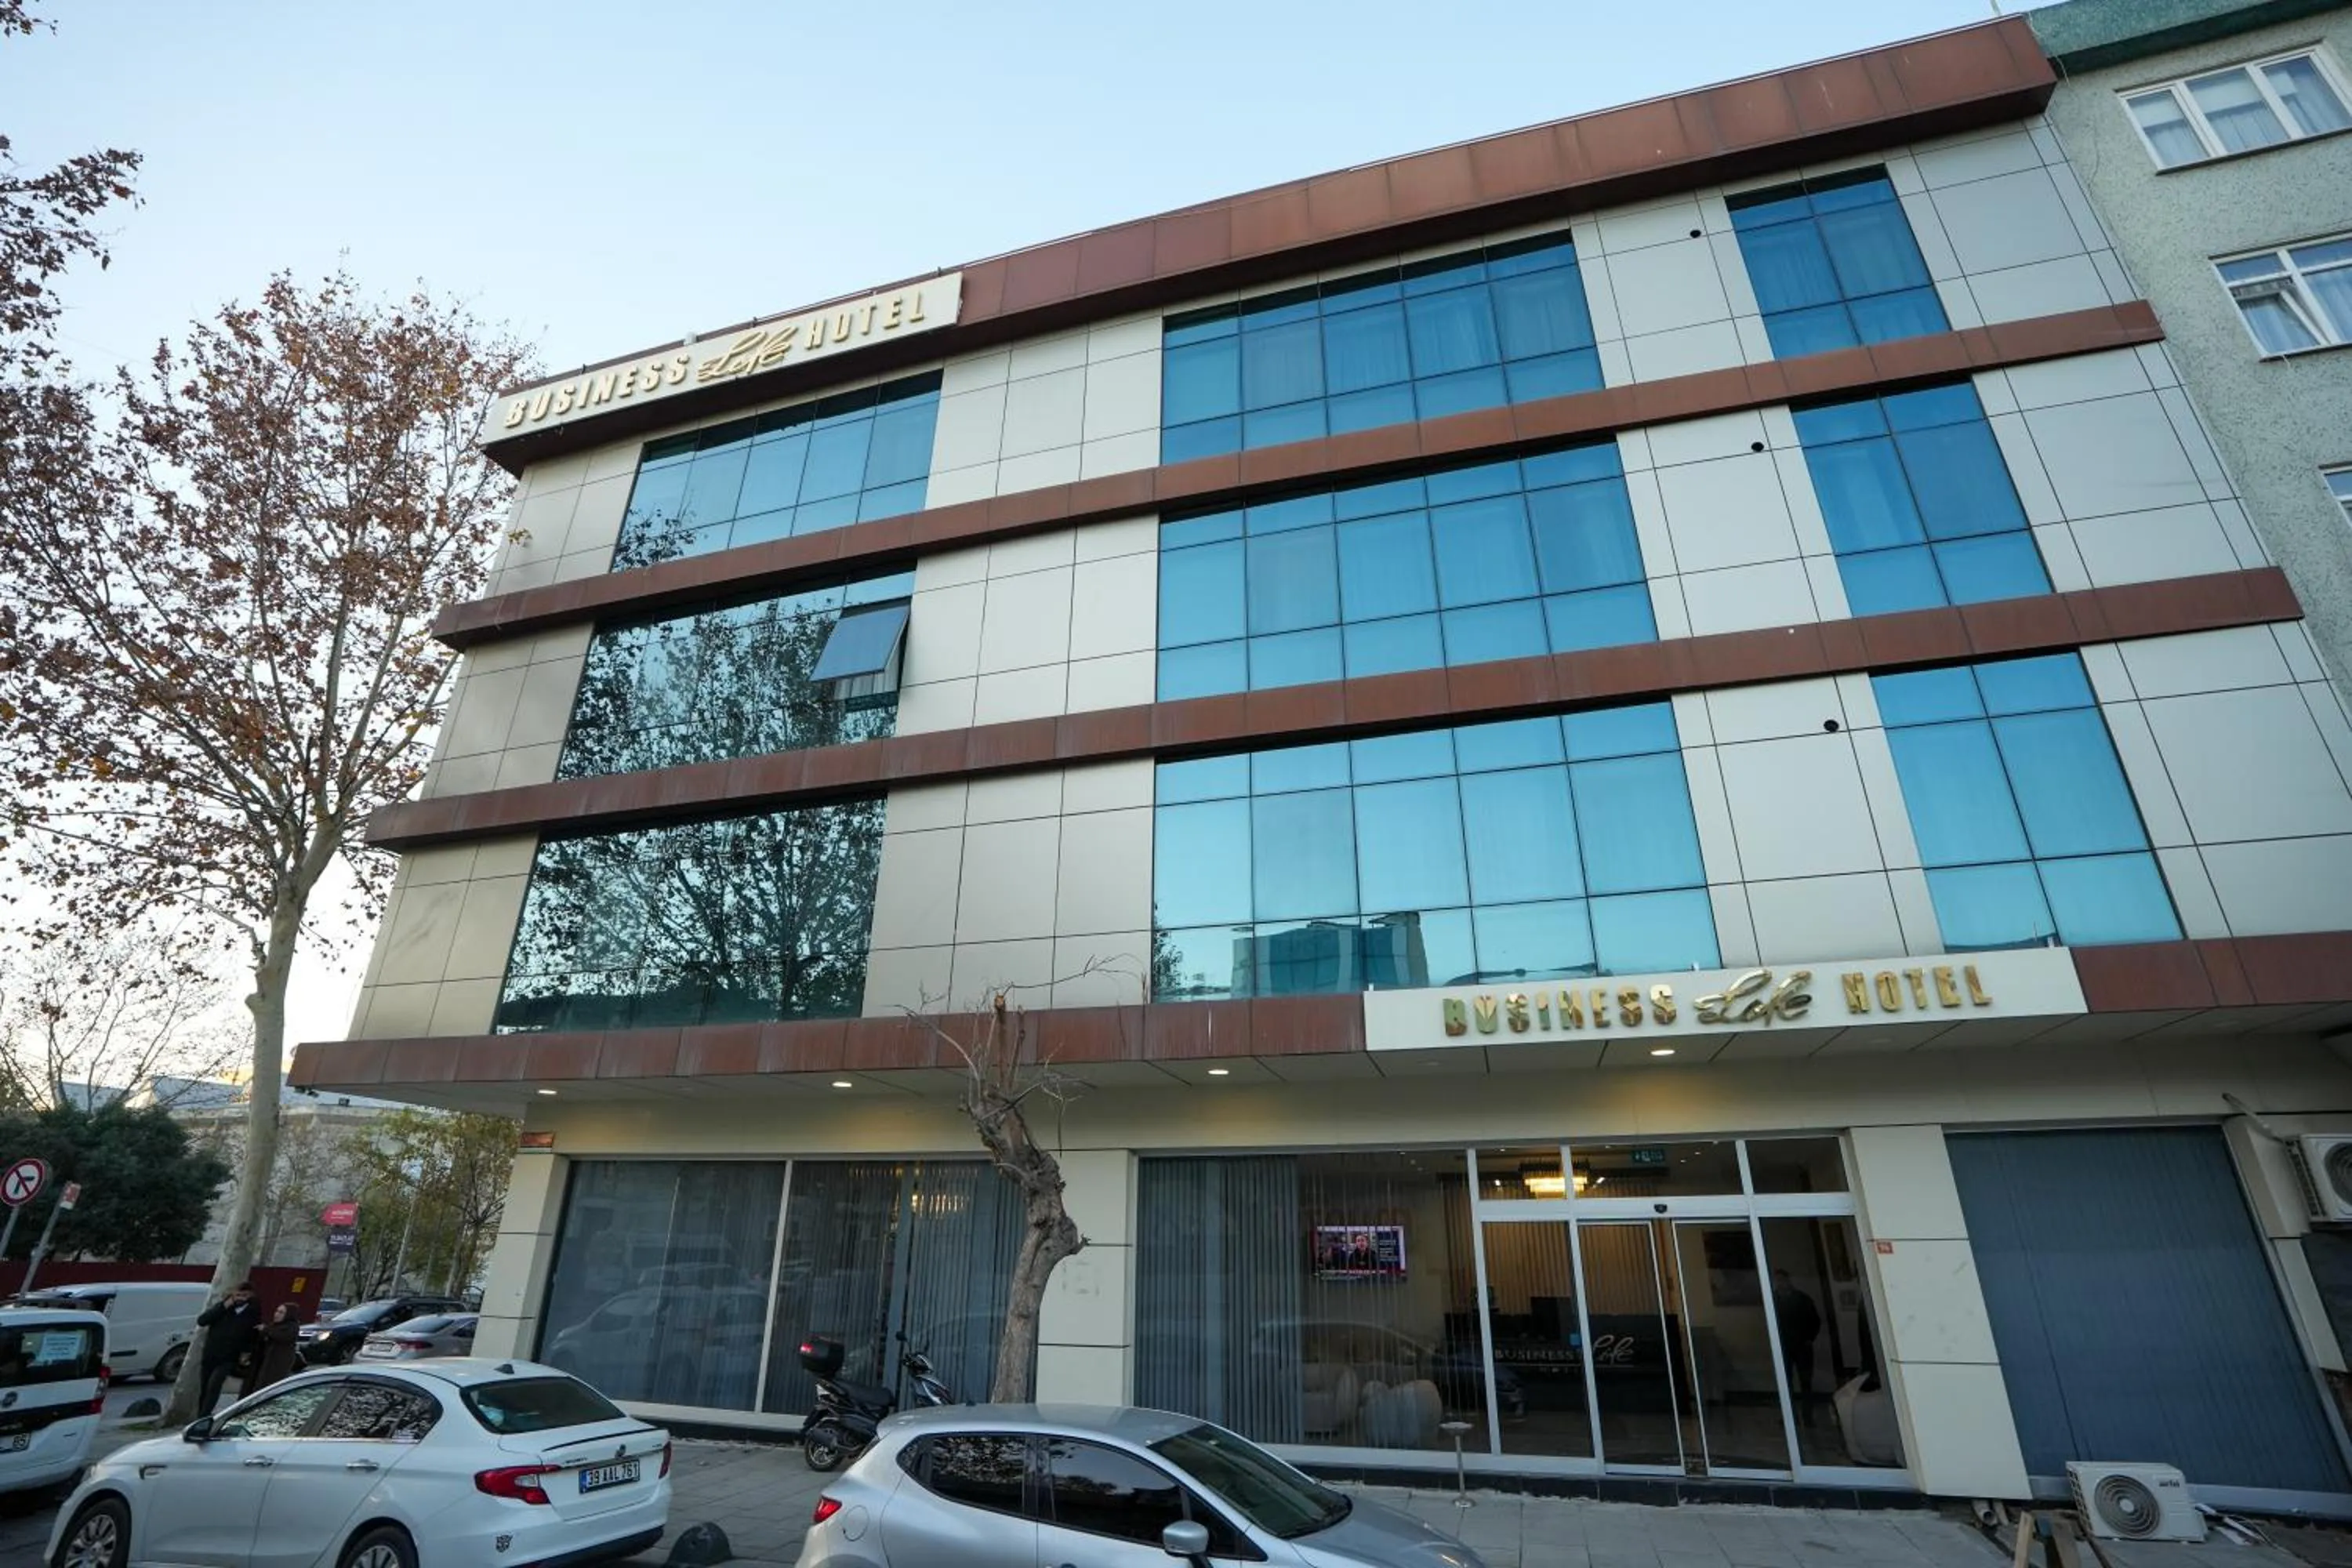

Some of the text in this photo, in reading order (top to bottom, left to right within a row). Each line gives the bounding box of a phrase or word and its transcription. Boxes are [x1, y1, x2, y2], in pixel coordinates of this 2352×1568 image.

[505, 353, 690, 429] BUSINESS
[804, 291, 924, 351] HOTEL
[1443, 983, 1678, 1037] BUSINESS
[1841, 965, 1993, 1014] HOTEL
[1494, 1348, 1576, 1360] BUSINESS
[588, 1470, 600, 1486] 39
